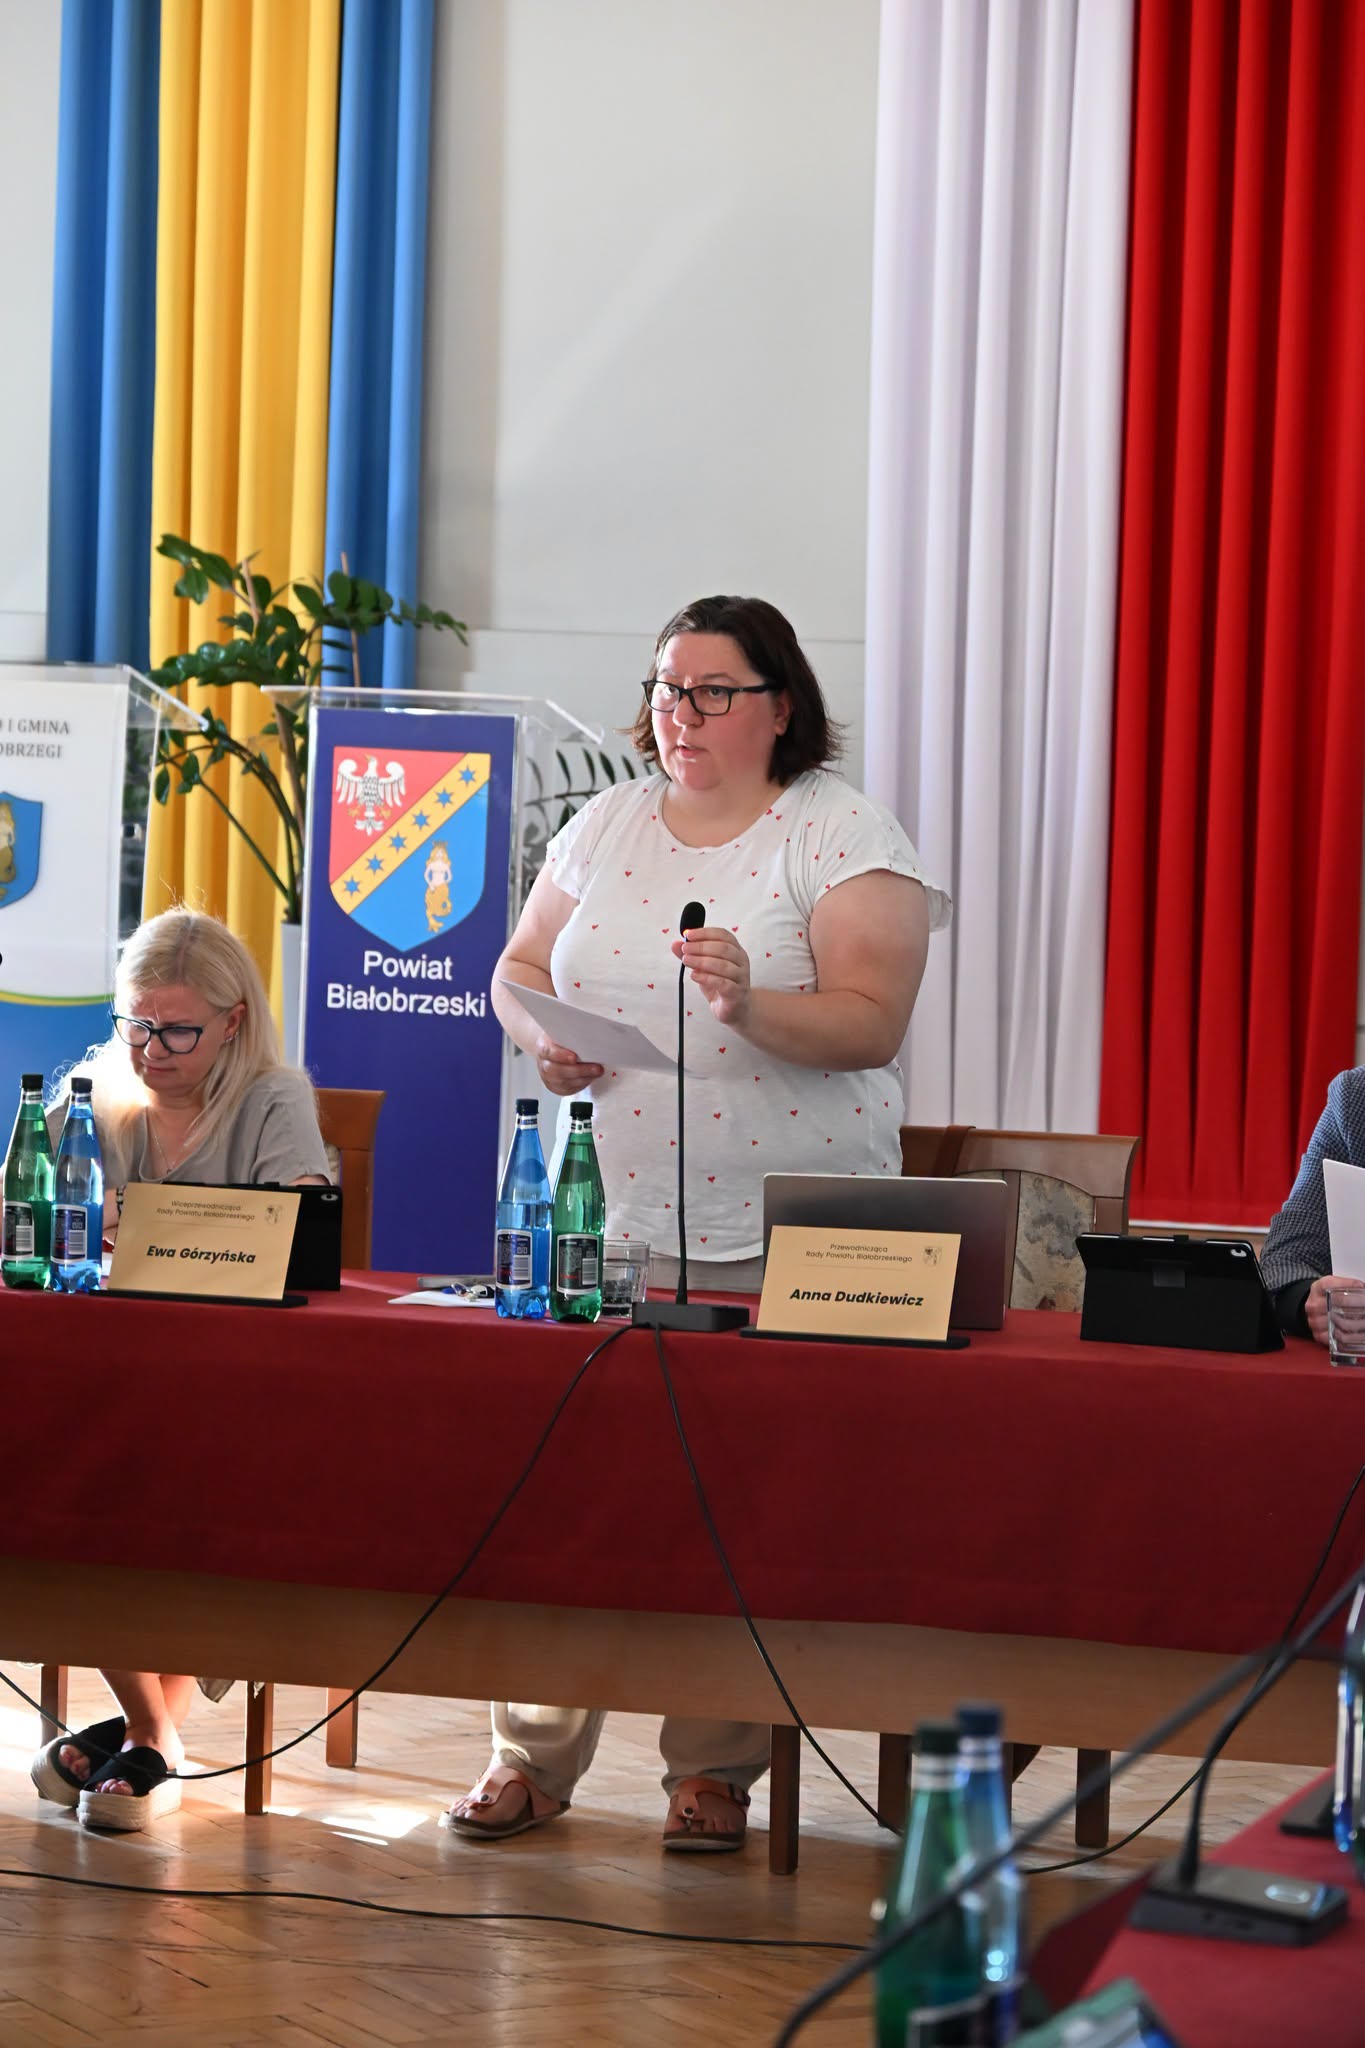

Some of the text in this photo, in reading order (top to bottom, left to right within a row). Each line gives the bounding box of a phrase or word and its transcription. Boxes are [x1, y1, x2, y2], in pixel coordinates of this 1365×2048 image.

[17, 719, 70, 735] GMINA
[363, 950, 453, 981] Powiat
[326, 983, 486, 1018] Białobrzeski
[156, 1207, 174, 1216] Rady
[175, 1209, 202, 1217] Powiatu
[146, 1246, 256, 1264] Ewa Górzyńska
[830, 1243, 888, 1253] Przewodnicząca
[806, 1251, 912, 1264] Rady Powiatu Białobrzeskiego
[790, 1288, 924, 1306] Anna Dudkiewicz
